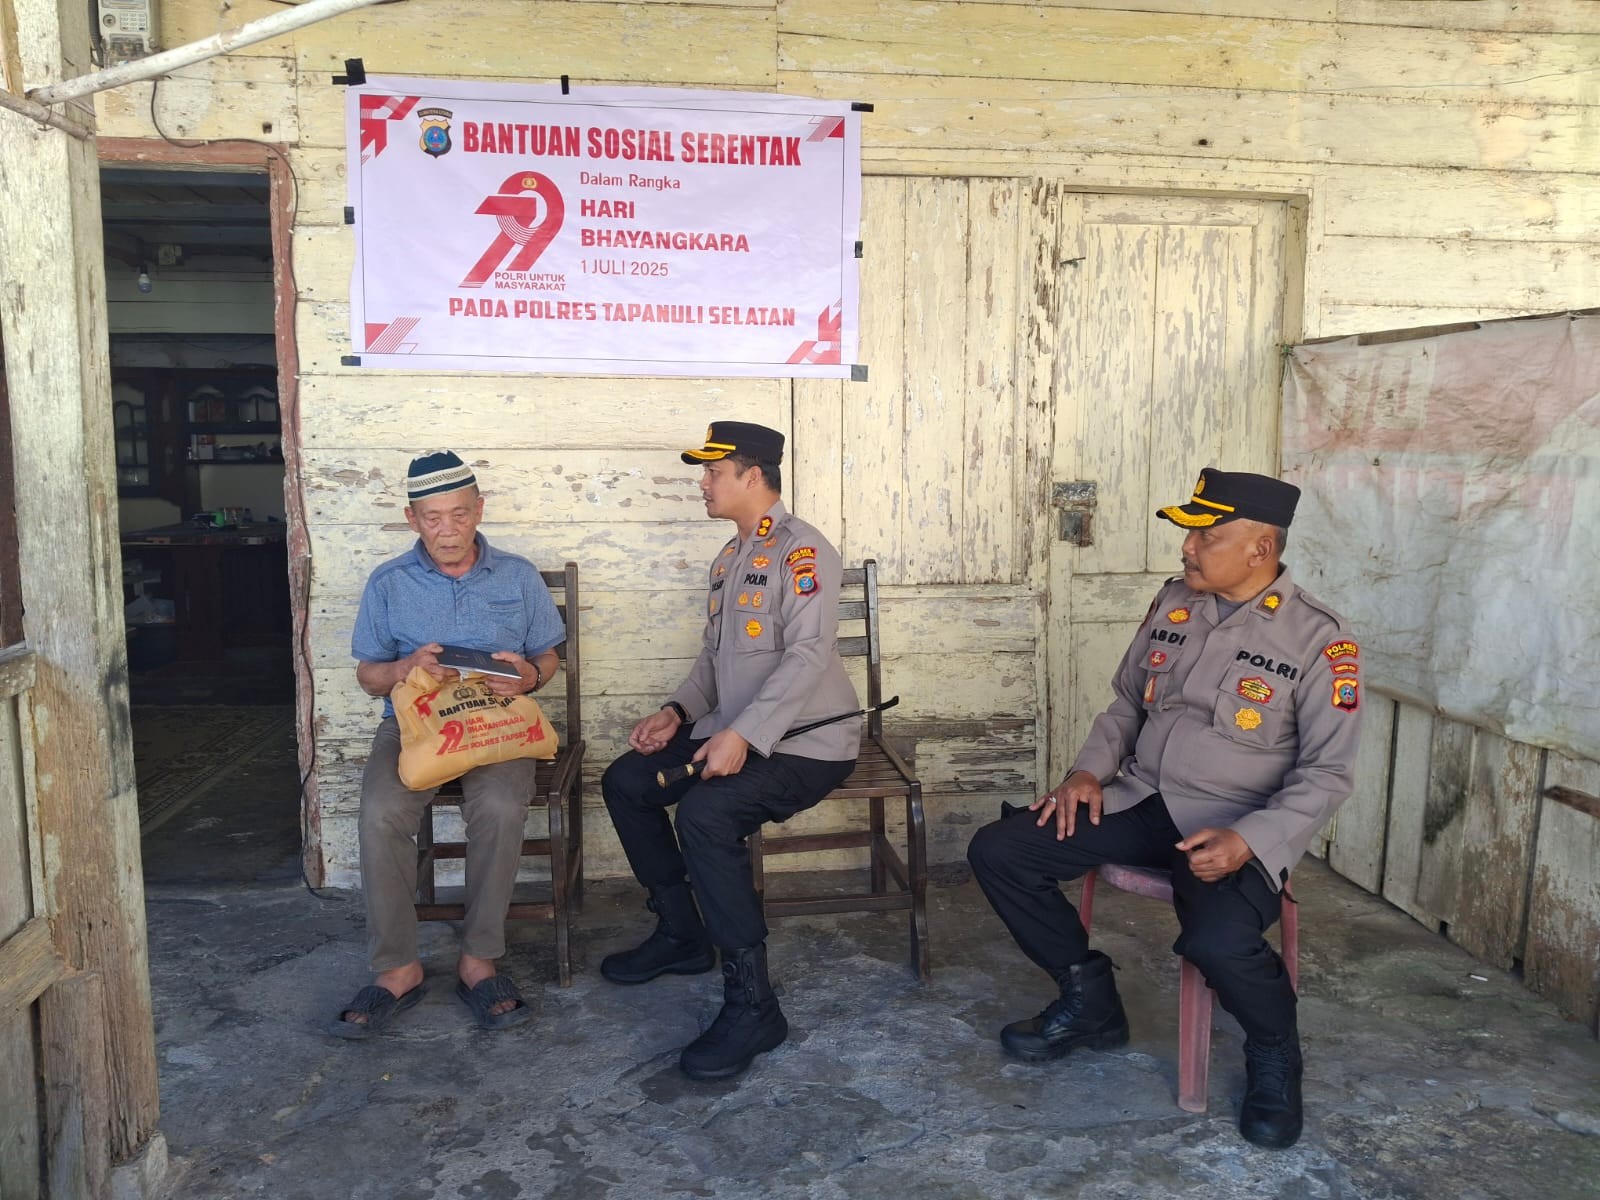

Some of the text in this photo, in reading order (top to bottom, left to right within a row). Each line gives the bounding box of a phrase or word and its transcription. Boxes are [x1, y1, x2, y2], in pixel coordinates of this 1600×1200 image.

[463, 121, 801, 167] BANTUAN SOSIAL SERENTAK
[580, 171, 681, 191] Dalam Rangka
[580, 199, 635, 219] HARI
[581, 228, 750, 252] BHAYANGKARA
[494, 271, 565, 282] POLRI UNTUK
[581, 259, 669, 277] 1 JULI 2025
[494, 281, 566, 291] MASYARAKAT
[449, 297, 796, 326] PADA POLRES TAPANULI SELATAN
[744, 573, 768, 586] POLRI
[1150, 628, 1187, 646] ABDI
[1326, 643, 1357, 656] POLRES
[1236, 650, 1298, 681] POLRI
[438, 699, 487, 717] BANTUAN
[470, 737, 500, 749] POLRES
